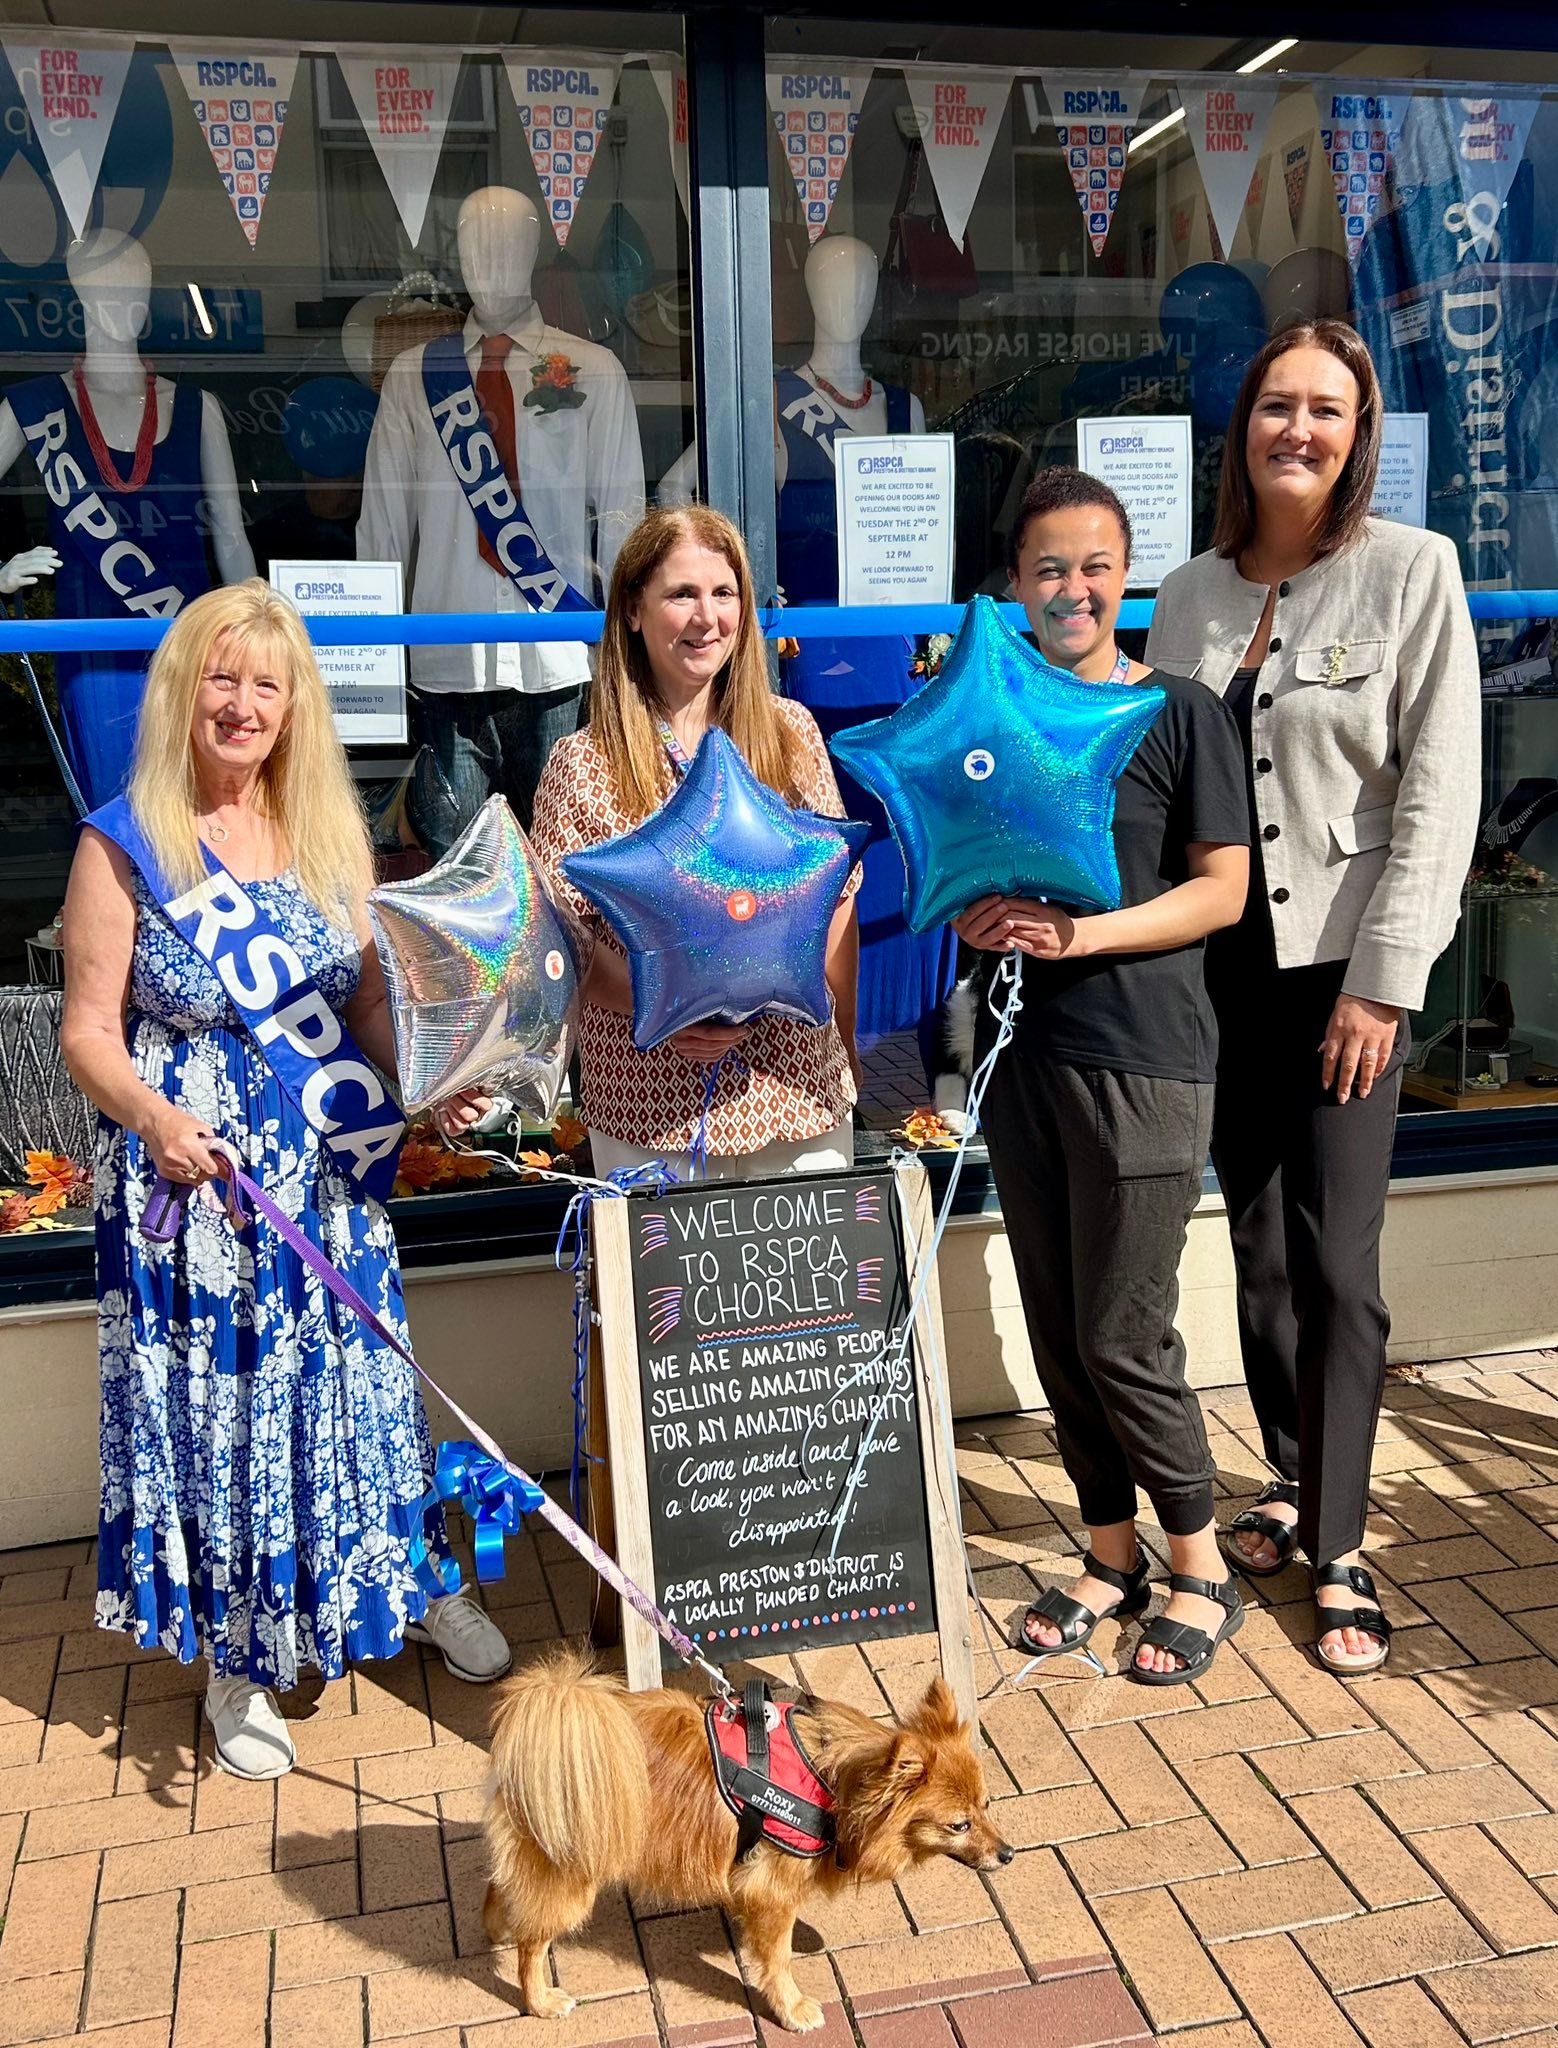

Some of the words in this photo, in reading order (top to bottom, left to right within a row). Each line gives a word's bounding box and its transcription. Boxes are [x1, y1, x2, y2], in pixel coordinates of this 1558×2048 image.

[40, 49, 78, 72] FOR
[41, 73, 103, 96] EVERY
[197, 61, 277, 88] RSPCA.
[374, 67, 410, 89] FOR
[527, 68, 599, 96] RSPCA.
[781, 75, 851, 100] RSPCA.
[934, 83, 967, 105] FOR
[43, 96, 98, 119] KIND.
[376, 89, 434, 112] EVERY
[1064, 90, 1128, 114] RSPCA.
[1205, 90, 1236, 111] FOR
[378, 113, 430, 135] KIND.
[934, 106, 987, 126] EVERY
[1205, 112, 1254, 132] EVERY
[934, 126, 980, 147] KIND.
[1205, 132, 1249, 152] KIND.
[1115, 437, 1143, 448] RSPCA
[873, 456, 903, 468] RSPCA
[432, 384, 568, 613] RSPCA
[1135, 497, 1151, 506] THE
[1167, 497, 1177, 506] OF
[1374, 492, 1389, 500] THE
[1403, 492, 1413, 500] OF
[23, 408, 185, 618] RSPCA
[856, 519, 893, 528] TUESDAY
[895, 519, 911, 528] THE
[928, 519, 939, 527] OF
[1156, 512, 1167, 520] AT
[868, 534, 916, 542] SEPTEMBER
[918, 534, 928, 542] AT
[1137, 528, 1150, 536] PM
[886, 551, 895, 559] 12
[898, 551, 911, 559] PM
[312, 583, 344, 594] RSPCA
[338, 648, 355, 656] THE
[375, 648, 387, 656] OF
[319, 664, 362, 672] PTEMBER
[364, 664, 375, 672] AT
[163, 868, 407, 1182] RSPCA
[670, 1189, 846, 1242] WELCOME
[678, 1250, 720, 1285] TO
[741, 1234, 849, 1280] RSPCA
[694, 1268, 849, 1326] CHORLEY
[649, 1355, 681, 1381] WE
[688, 1348, 731, 1376] ARE
[741, 1338, 827, 1368] AMAZING
[838, 1327, 903, 1356] PEOPLE
[651, 1378, 742, 1417] SELLING
[749, 1364, 847, 1399] AMAZING
[850, 1357, 912, 1391] THINGS
[650, 1421, 692, 1453] FOR
[698, 1416, 728, 1445] AN
[734, 1403, 828, 1440] AMAZING
[831, 1392, 915, 1425] CHARITY
[677, 1456, 737, 1488] Come
[742, 1444, 802, 1476] inside
[808, 1435, 853, 1463] and
[858, 1431, 901, 1456] have
[665, 1502, 682, 1519] a
[690, 1489, 734, 1515] look,
[739, 1486, 776, 1517] you
[782, 1472, 836, 1493] won't
[664, 1579, 713, 1605] RSPCA
[719, 1563, 790, 1593] PRESTON
[809, 1554, 880, 1577] DISTRICT
[888, 1552, 905, 1571] IS
[666, 1609, 678, 1625] A
[684, 1597, 745, 1625] LOCALLY
[755, 1584, 820, 1616] FUNDED
[827, 1572, 900, 1600] CHARITY.
[764, 1786, 796, 1813] Roxy
